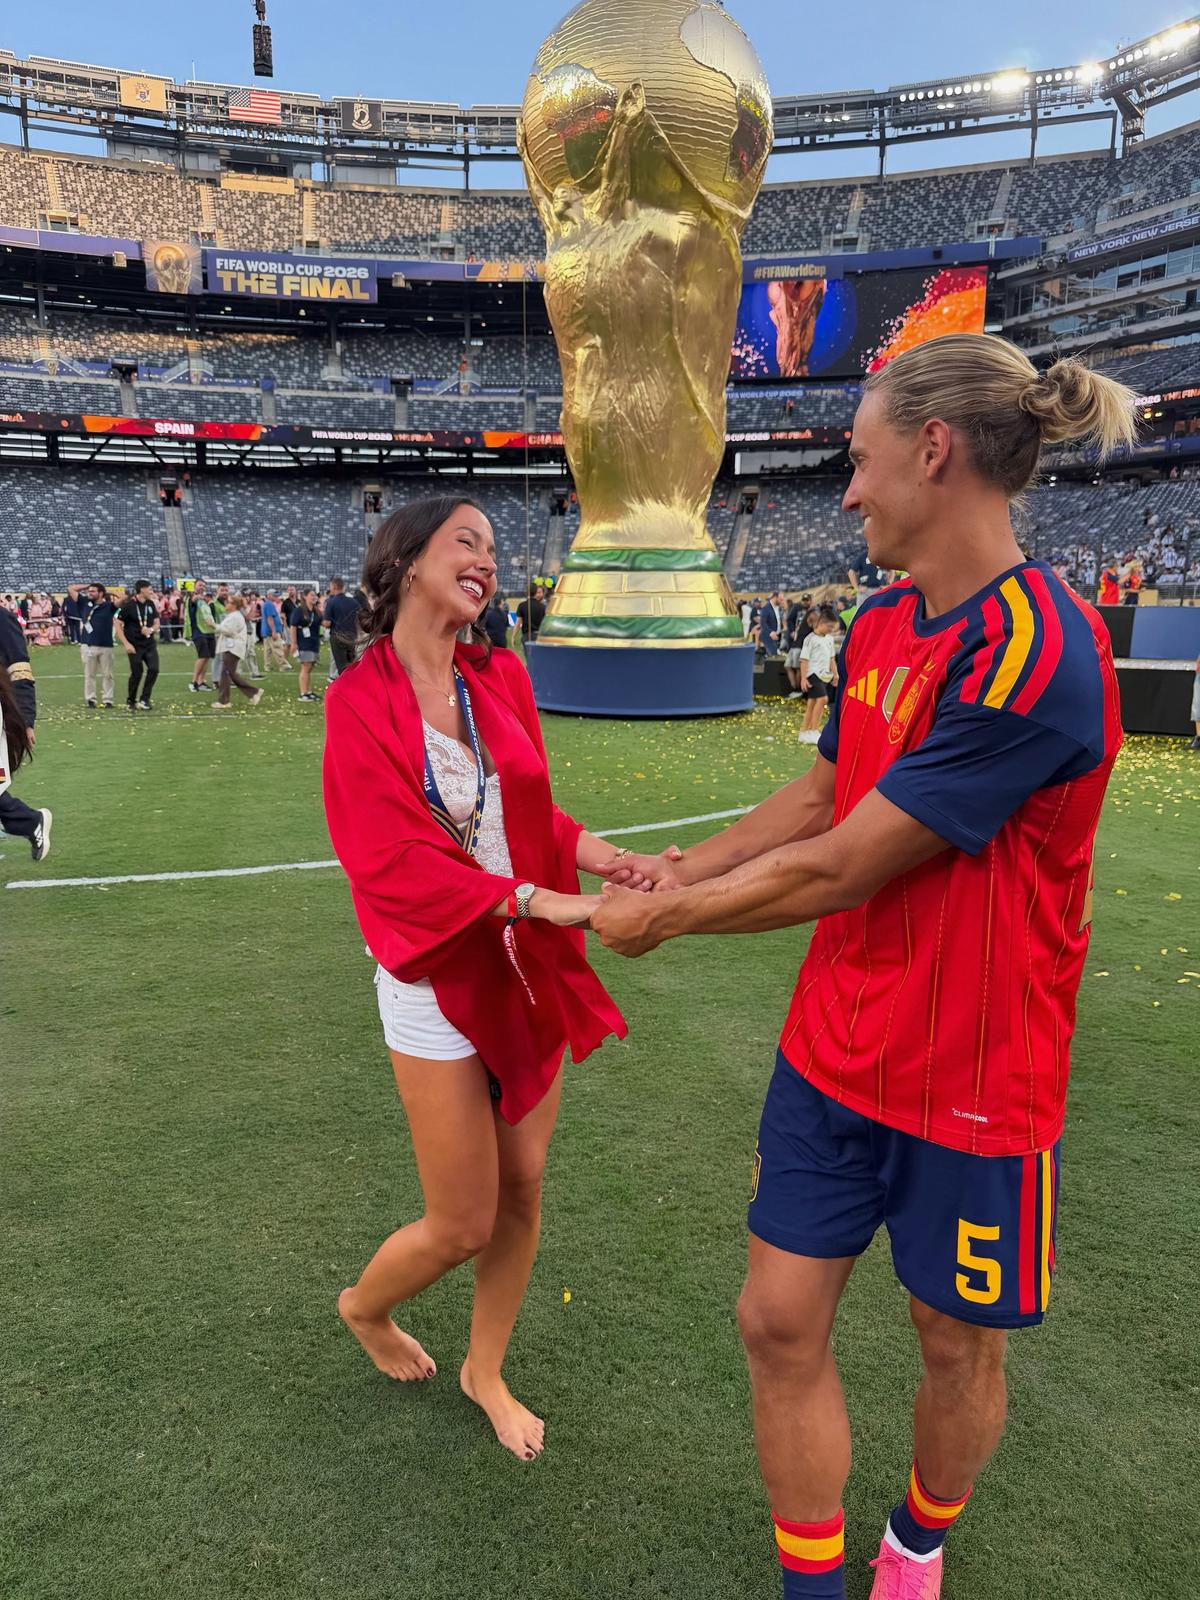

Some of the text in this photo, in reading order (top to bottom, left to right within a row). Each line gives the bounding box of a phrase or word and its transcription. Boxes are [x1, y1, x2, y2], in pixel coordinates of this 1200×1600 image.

[1074, 216, 1200, 259] NEW YORK NEW JERSE
[216, 258, 369, 278] FIFA WORLD CUP 2026
[754, 264, 826, 279] #FIFAWorldCup
[216, 271, 370, 300] THE FINAL
[740, 391, 765, 399] WORLD
[1134, 394, 1162, 406] 2026
[1162, 391, 1181, 401] THE
[154, 421, 195, 435] SPAIN
[312, 431, 328, 439] FIFA
[328, 431, 353, 440] WORLD
[353, 432, 367, 440] CUP
[368, 433, 393, 441] 2026
[528, 434, 564, 446] CHAM
[730, 433, 745, 441] CUP
[745, 432, 770, 441] 2026
[463, 688, 471, 706] FIFA
[467, 706, 477, 737] WORLD
[955, 1217, 1002, 1305] 5
